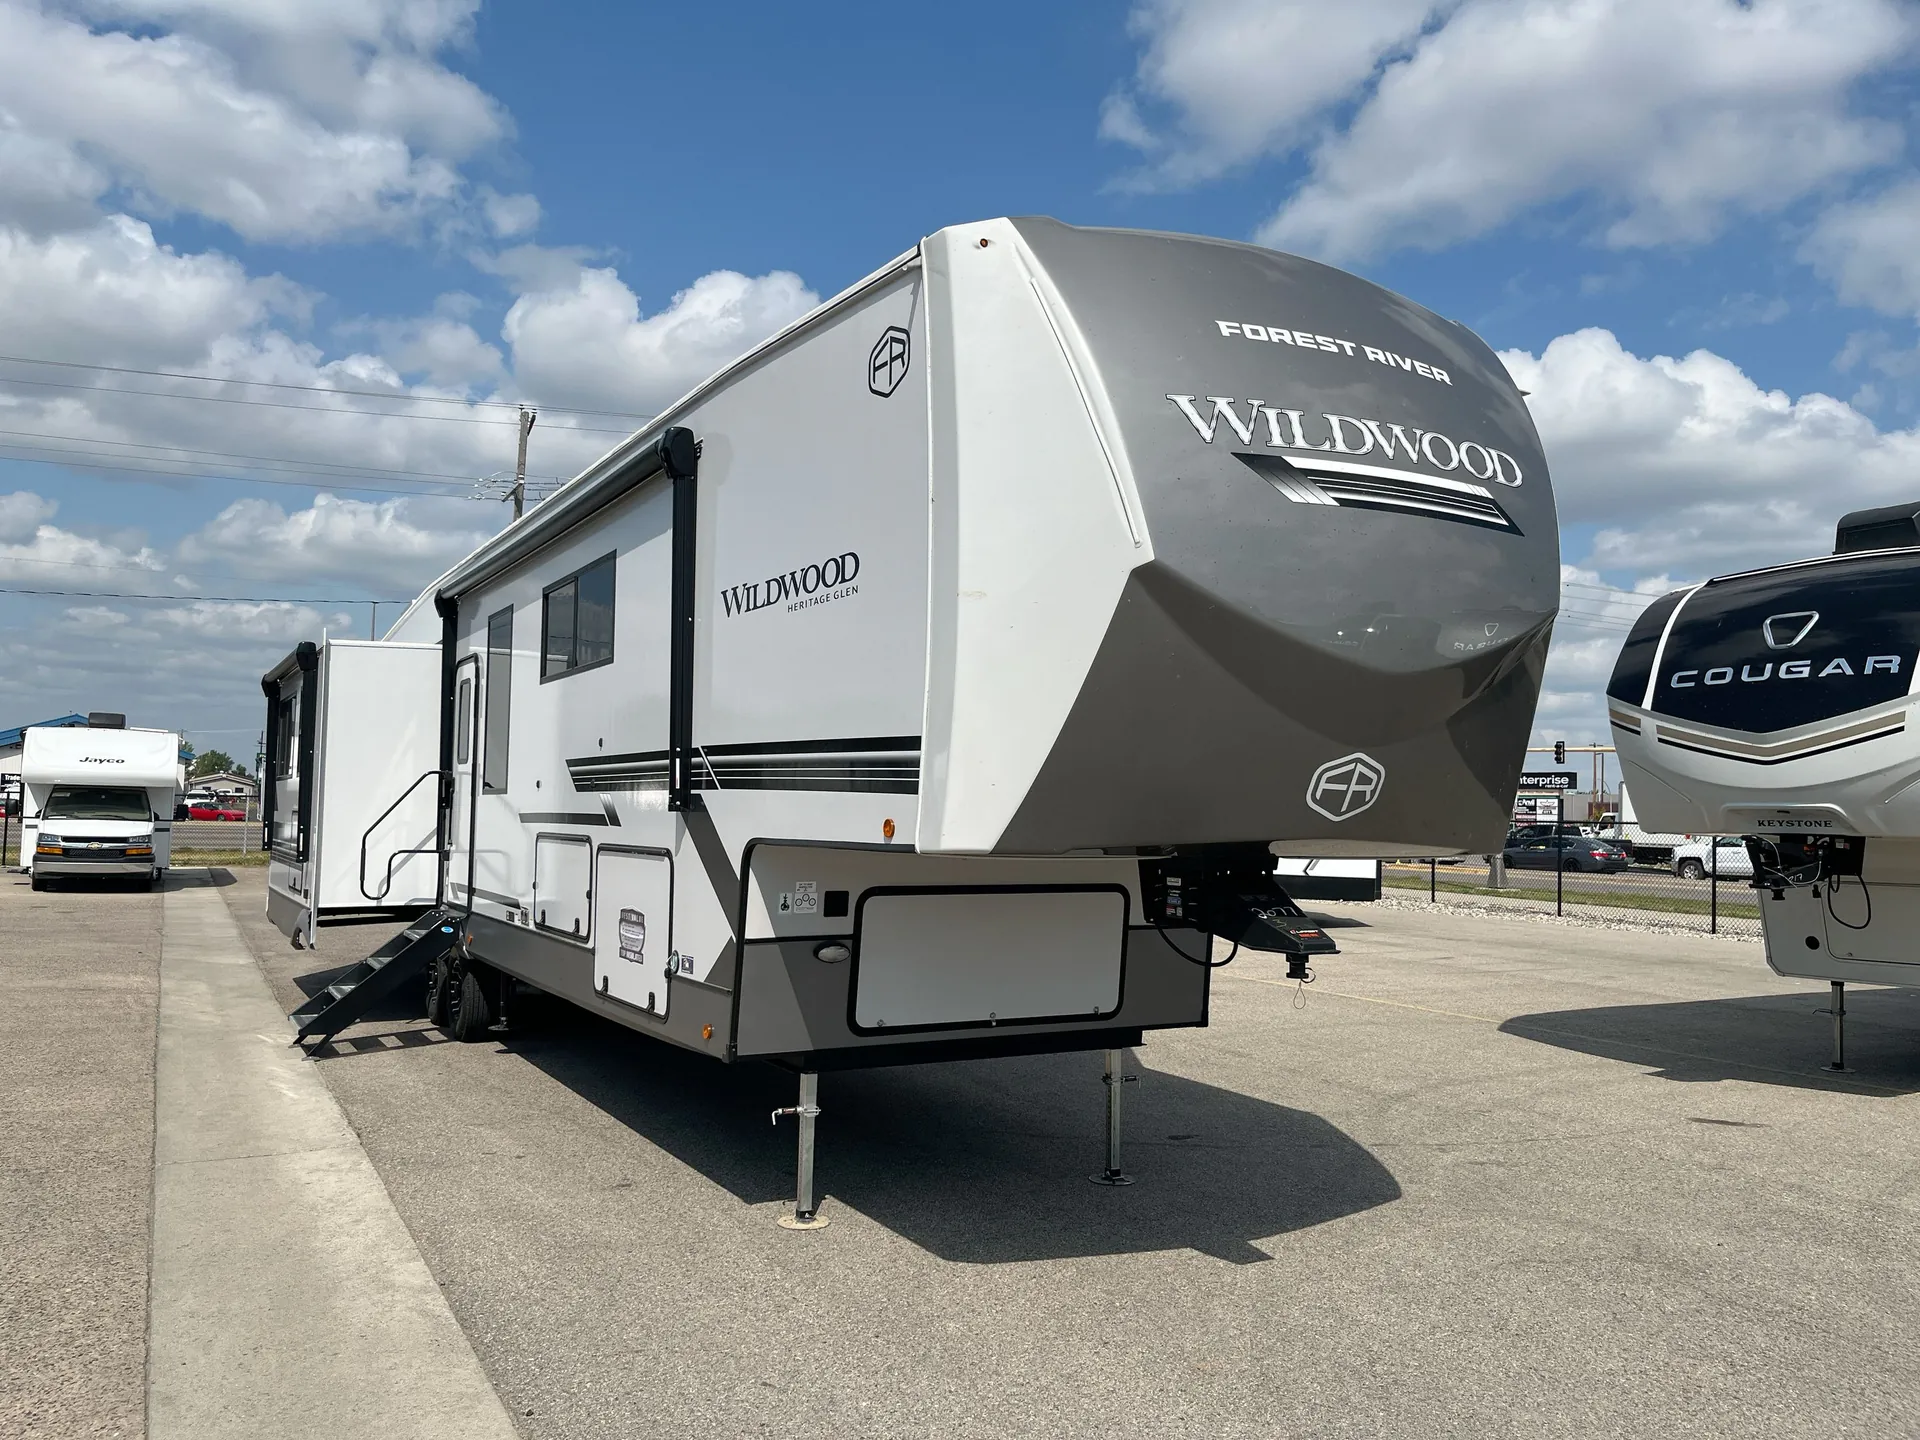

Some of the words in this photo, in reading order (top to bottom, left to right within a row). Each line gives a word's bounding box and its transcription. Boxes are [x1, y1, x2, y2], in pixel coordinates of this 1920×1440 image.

[1215, 319, 1356, 356] FOREST
[1361, 344, 1453, 387] RIVER
[1165, 393, 1524, 488] WILDWOOD
[720, 551, 860, 619] WILDWOOD
[787, 594, 831, 613] HERITAGE
[833, 585, 859, 601] GLEN
[1670, 655, 1901, 689] COUGAR
[79, 756, 125, 764] Jayco
[1757, 819, 1833, 828] KEYSTONE
[1251, 906, 1299, 919] 2077
